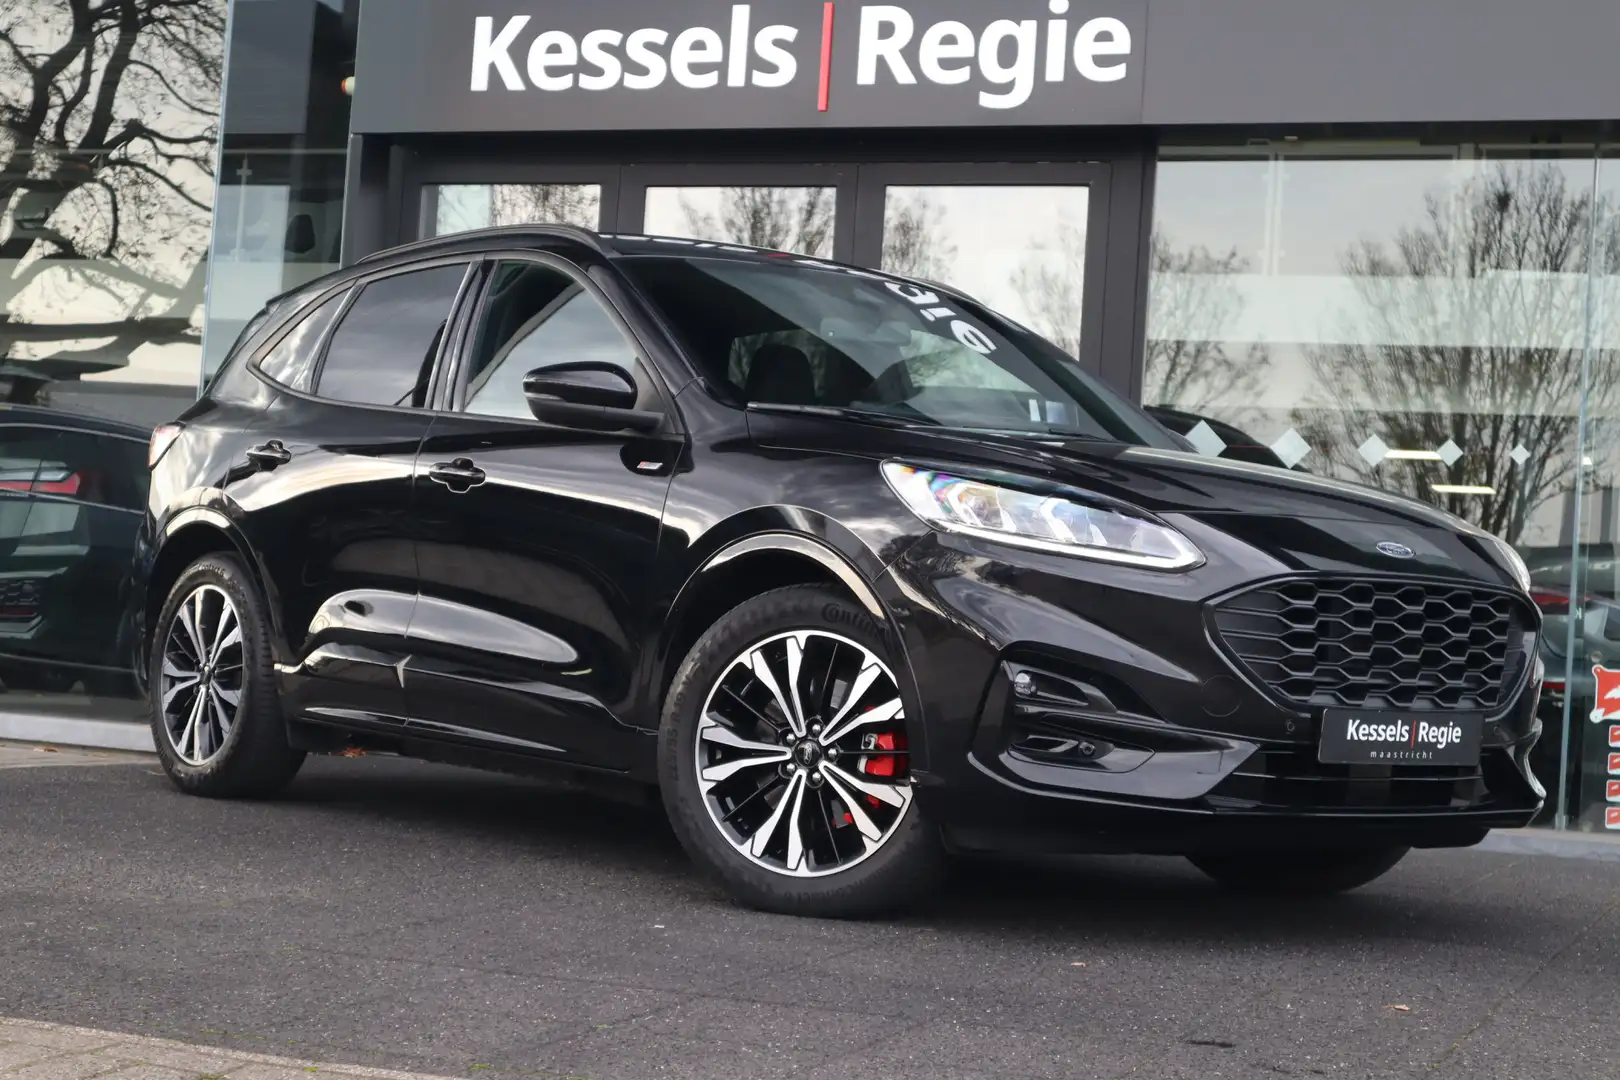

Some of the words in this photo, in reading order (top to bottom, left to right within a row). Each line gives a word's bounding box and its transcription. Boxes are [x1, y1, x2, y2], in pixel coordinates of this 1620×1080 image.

[470, 4, 799, 92] Kessels
[856, 0, 1132, 109] Regie
[1346, 718, 1410, 743] Kessels
[1417, 720, 1462, 750] Regie
[1370, 750, 1433, 760] maastricht
